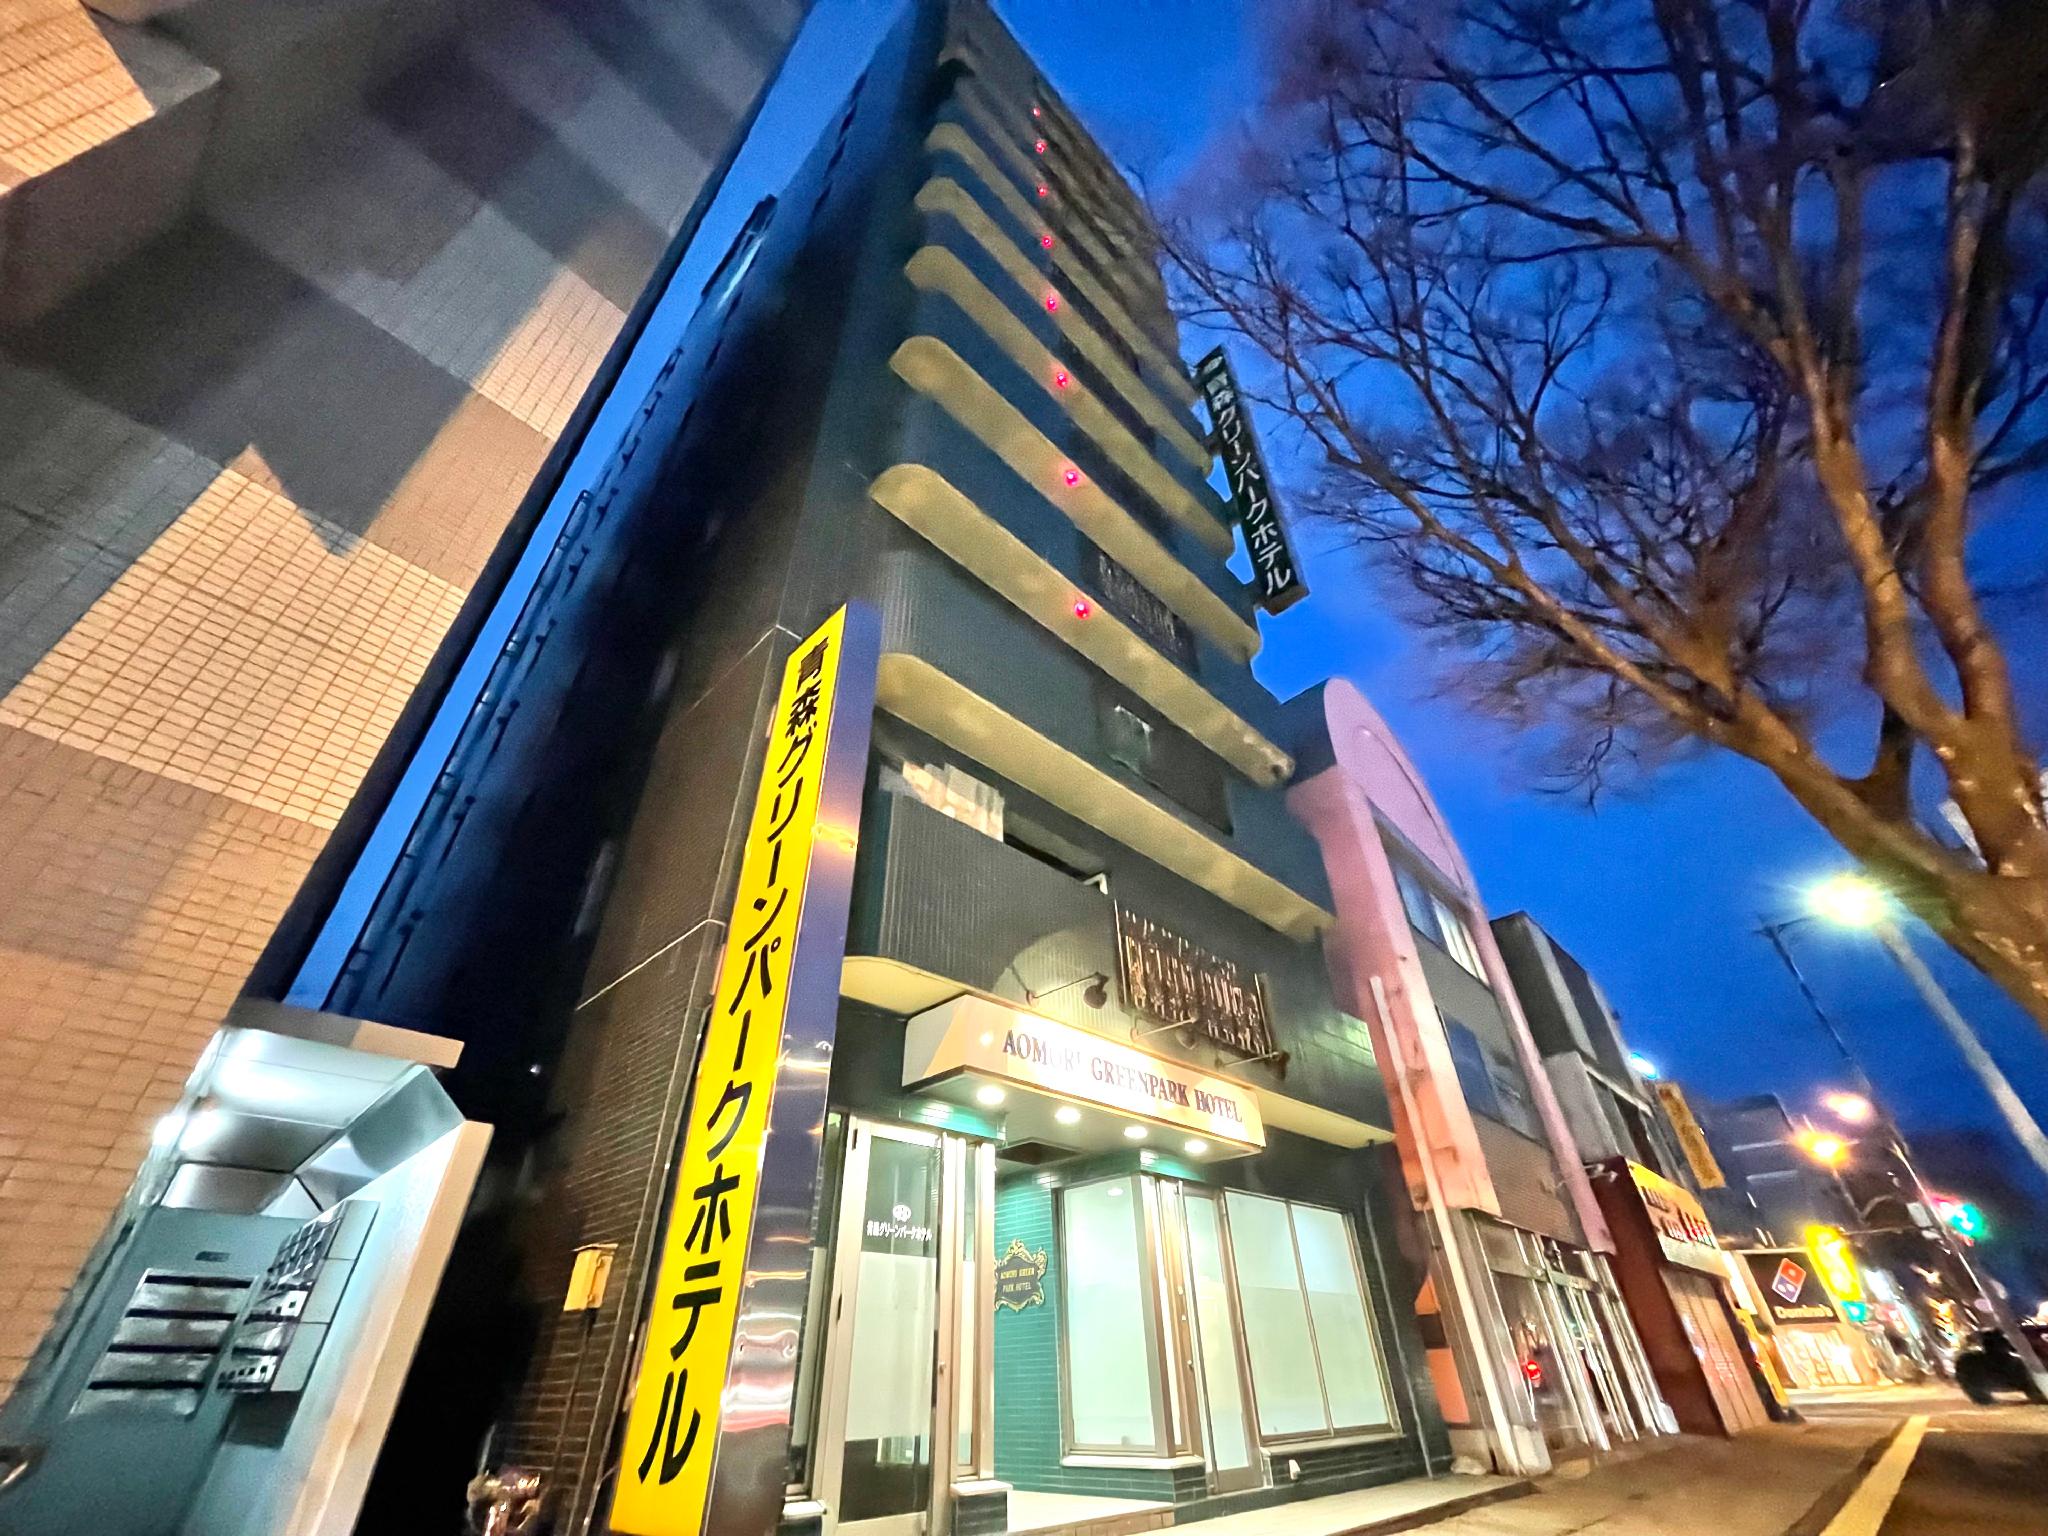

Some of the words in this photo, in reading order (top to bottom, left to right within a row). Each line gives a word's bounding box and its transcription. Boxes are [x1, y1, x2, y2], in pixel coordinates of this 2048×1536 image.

[637, 636, 829, 1486] 青森グリーンパークホテル
[1002, 1029, 1081, 1072] AOMORI
[1090, 1056, 1190, 1107] GREENPARK
[1194, 1088, 1243, 1123] HOTEL
